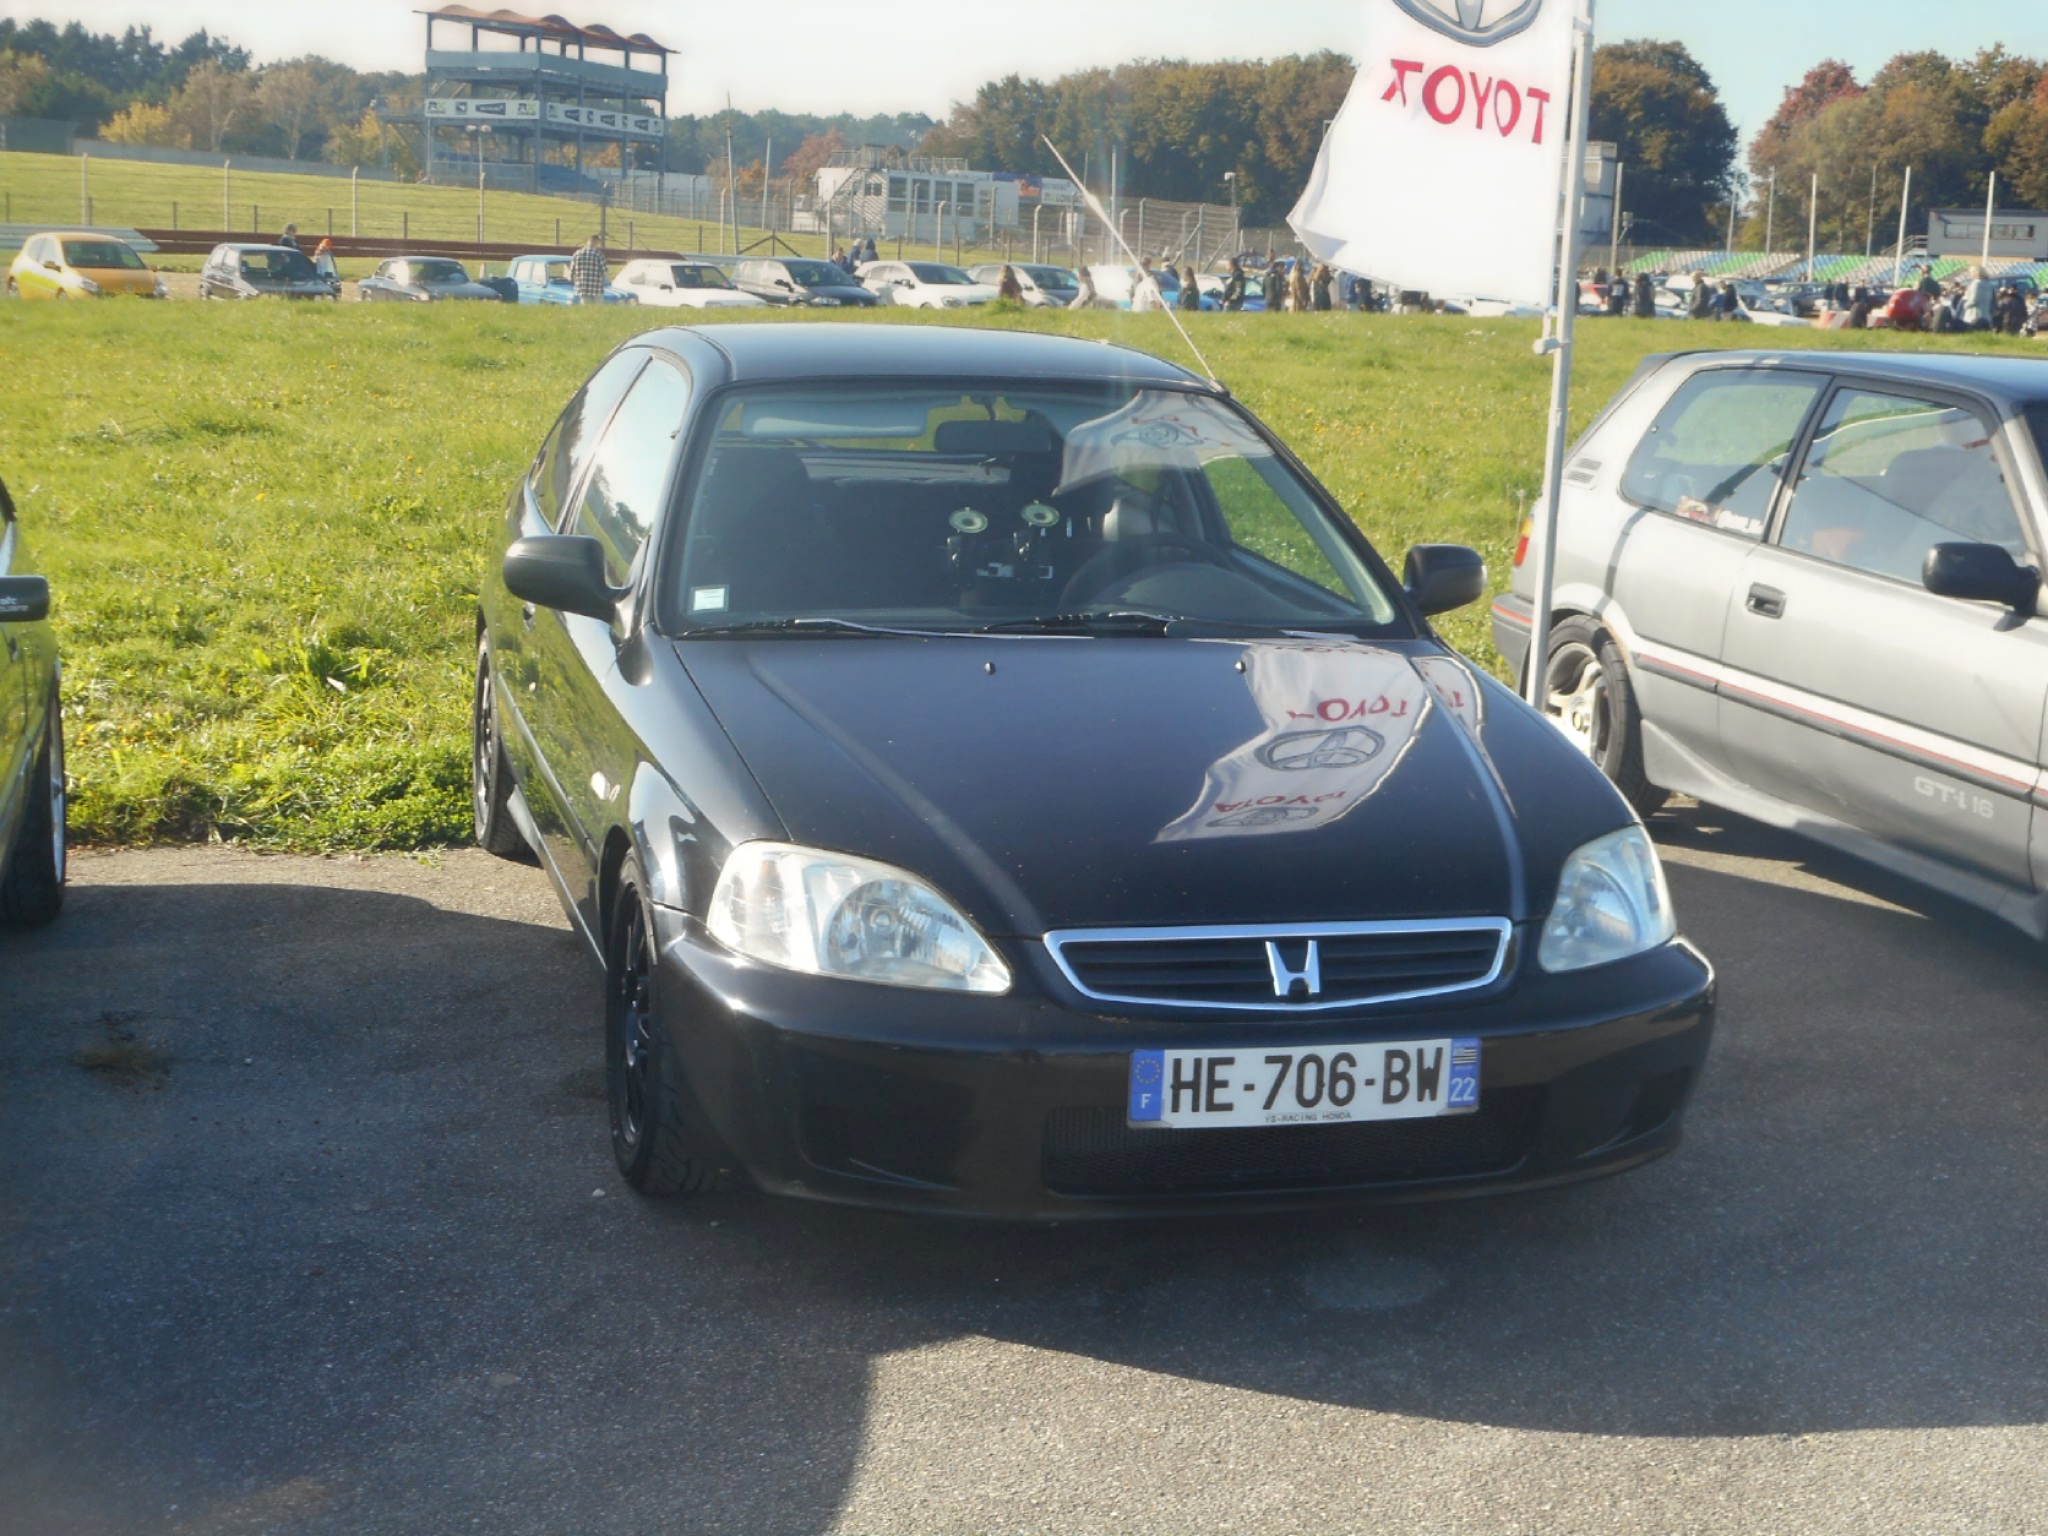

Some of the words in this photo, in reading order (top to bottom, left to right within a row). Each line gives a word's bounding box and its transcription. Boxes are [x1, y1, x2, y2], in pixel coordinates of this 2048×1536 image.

[1170, 1047, 1444, 1113] HE-706-BW
[1449, 1077, 1477, 1102] 22
[1140, 1093, 1152, 1109] F
[1322, 1111, 1352, 1121] HONDA
